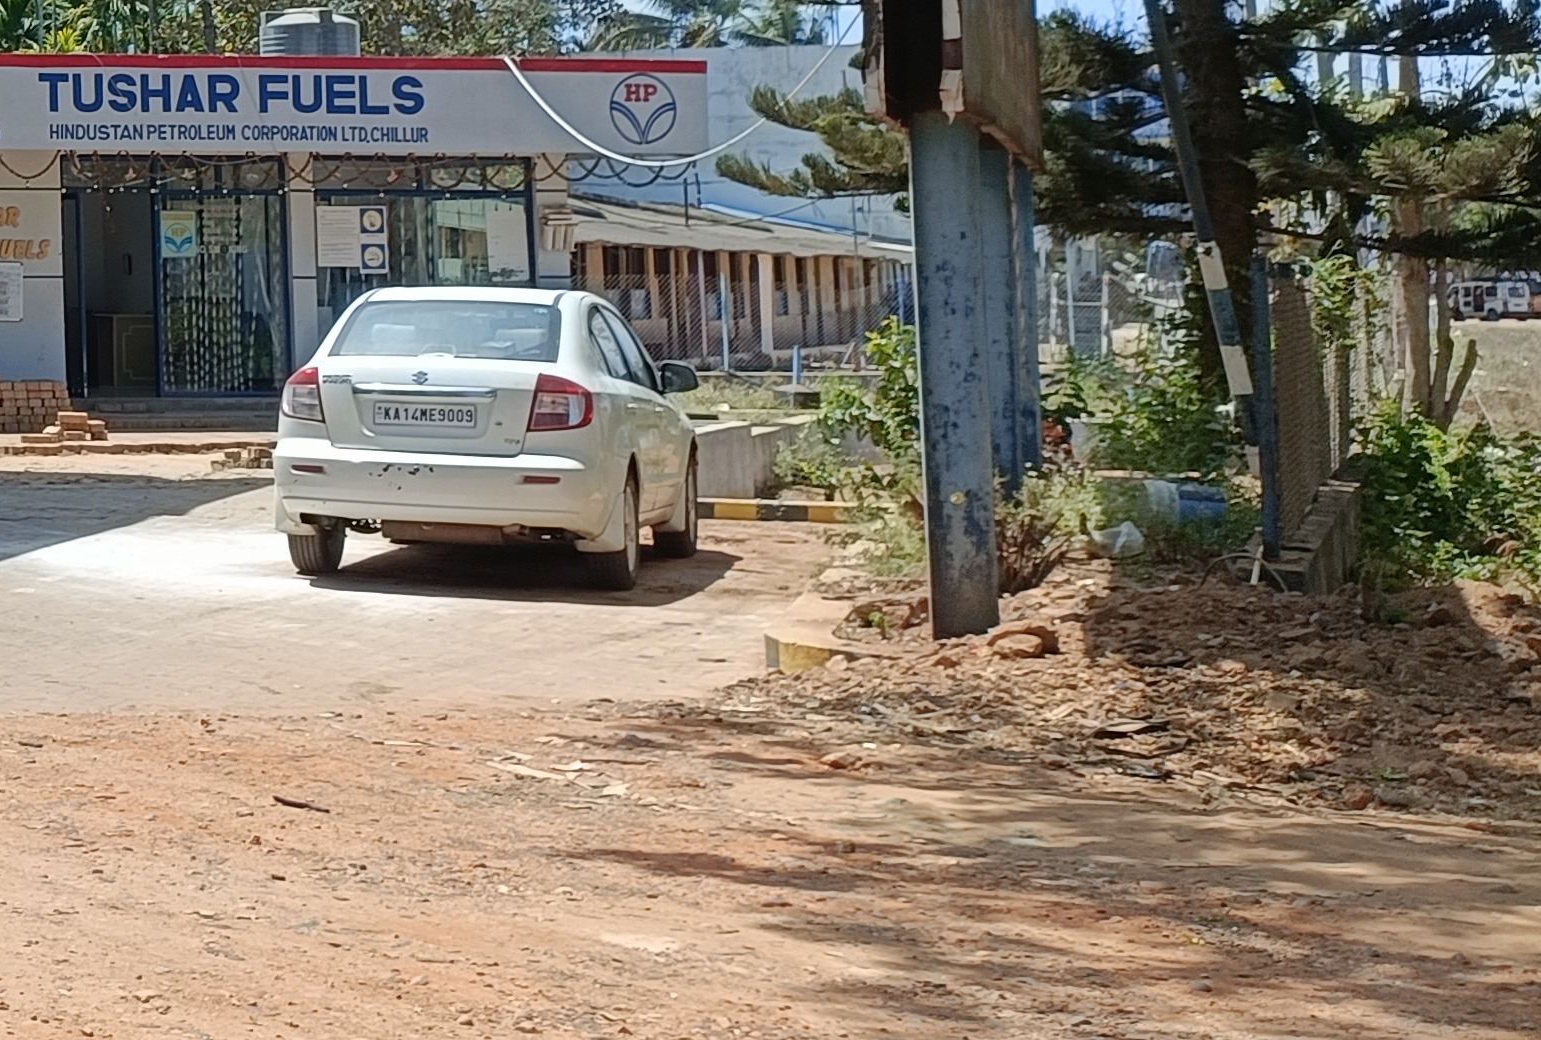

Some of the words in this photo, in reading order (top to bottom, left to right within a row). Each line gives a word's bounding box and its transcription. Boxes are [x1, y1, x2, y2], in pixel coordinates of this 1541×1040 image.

[38, 72, 241, 114] TUSHAR
[258, 74, 426, 115] FUELS
[623, 82, 658, 103] HP
[49, 123, 144, 141] HINDUSTAN
[146, 124, 236, 142] PETROLEUM
[241, 125, 338, 143] CORPORATION
[383, 406, 474, 424] KA14ME9009
